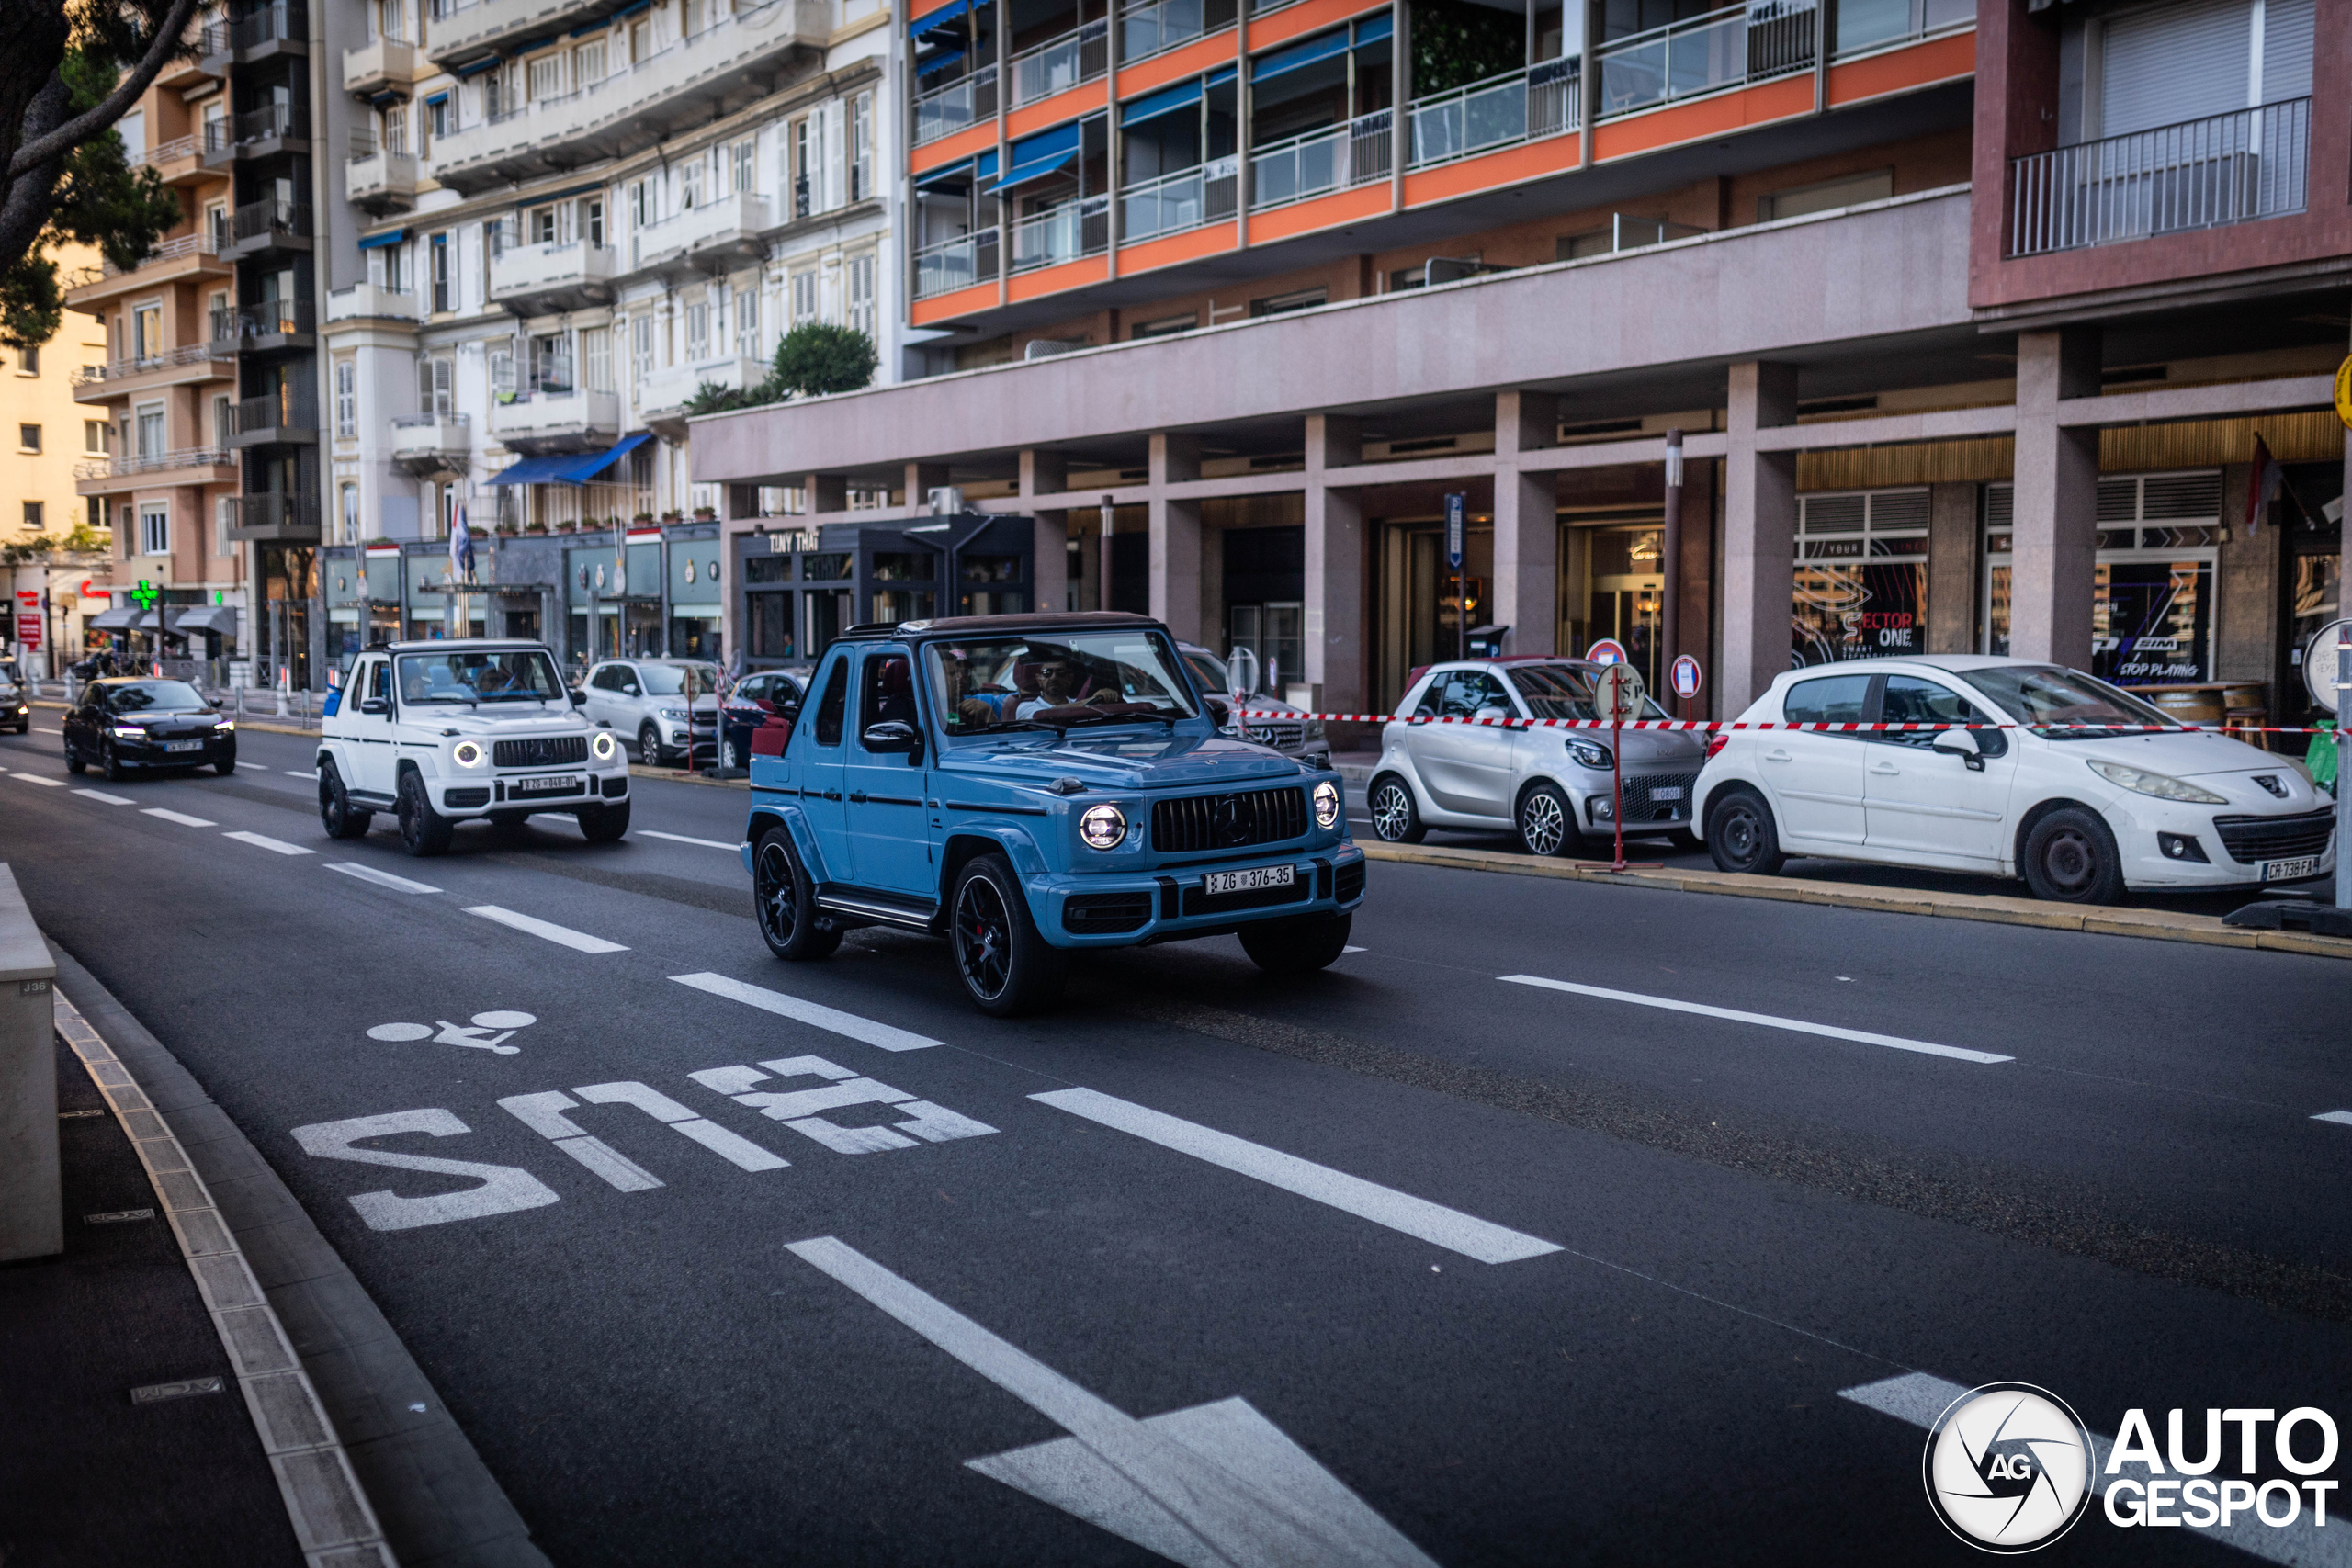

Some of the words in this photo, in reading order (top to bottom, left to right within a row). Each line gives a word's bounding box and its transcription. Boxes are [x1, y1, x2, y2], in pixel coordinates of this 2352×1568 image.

[769, 533, 793, 553] TINY
[1830, 543, 1858, 553] YOUR
[1843, 612, 1912, 641] SECTOR
[1879, 628, 1912, 647] ONE
[1491, 645, 1499, 658] P
[1842, 645, 1872, 653] SMART
[2120, 663, 2148, 675] STOP
[2149, 663, 2199, 676] PLAYING
[1222, 874, 1237, 890] ZG
[1250, 867, 1290, 887] 376-35
[24, 983, 46, 992] J36
[289, 1055, 1001, 1232] BUS
